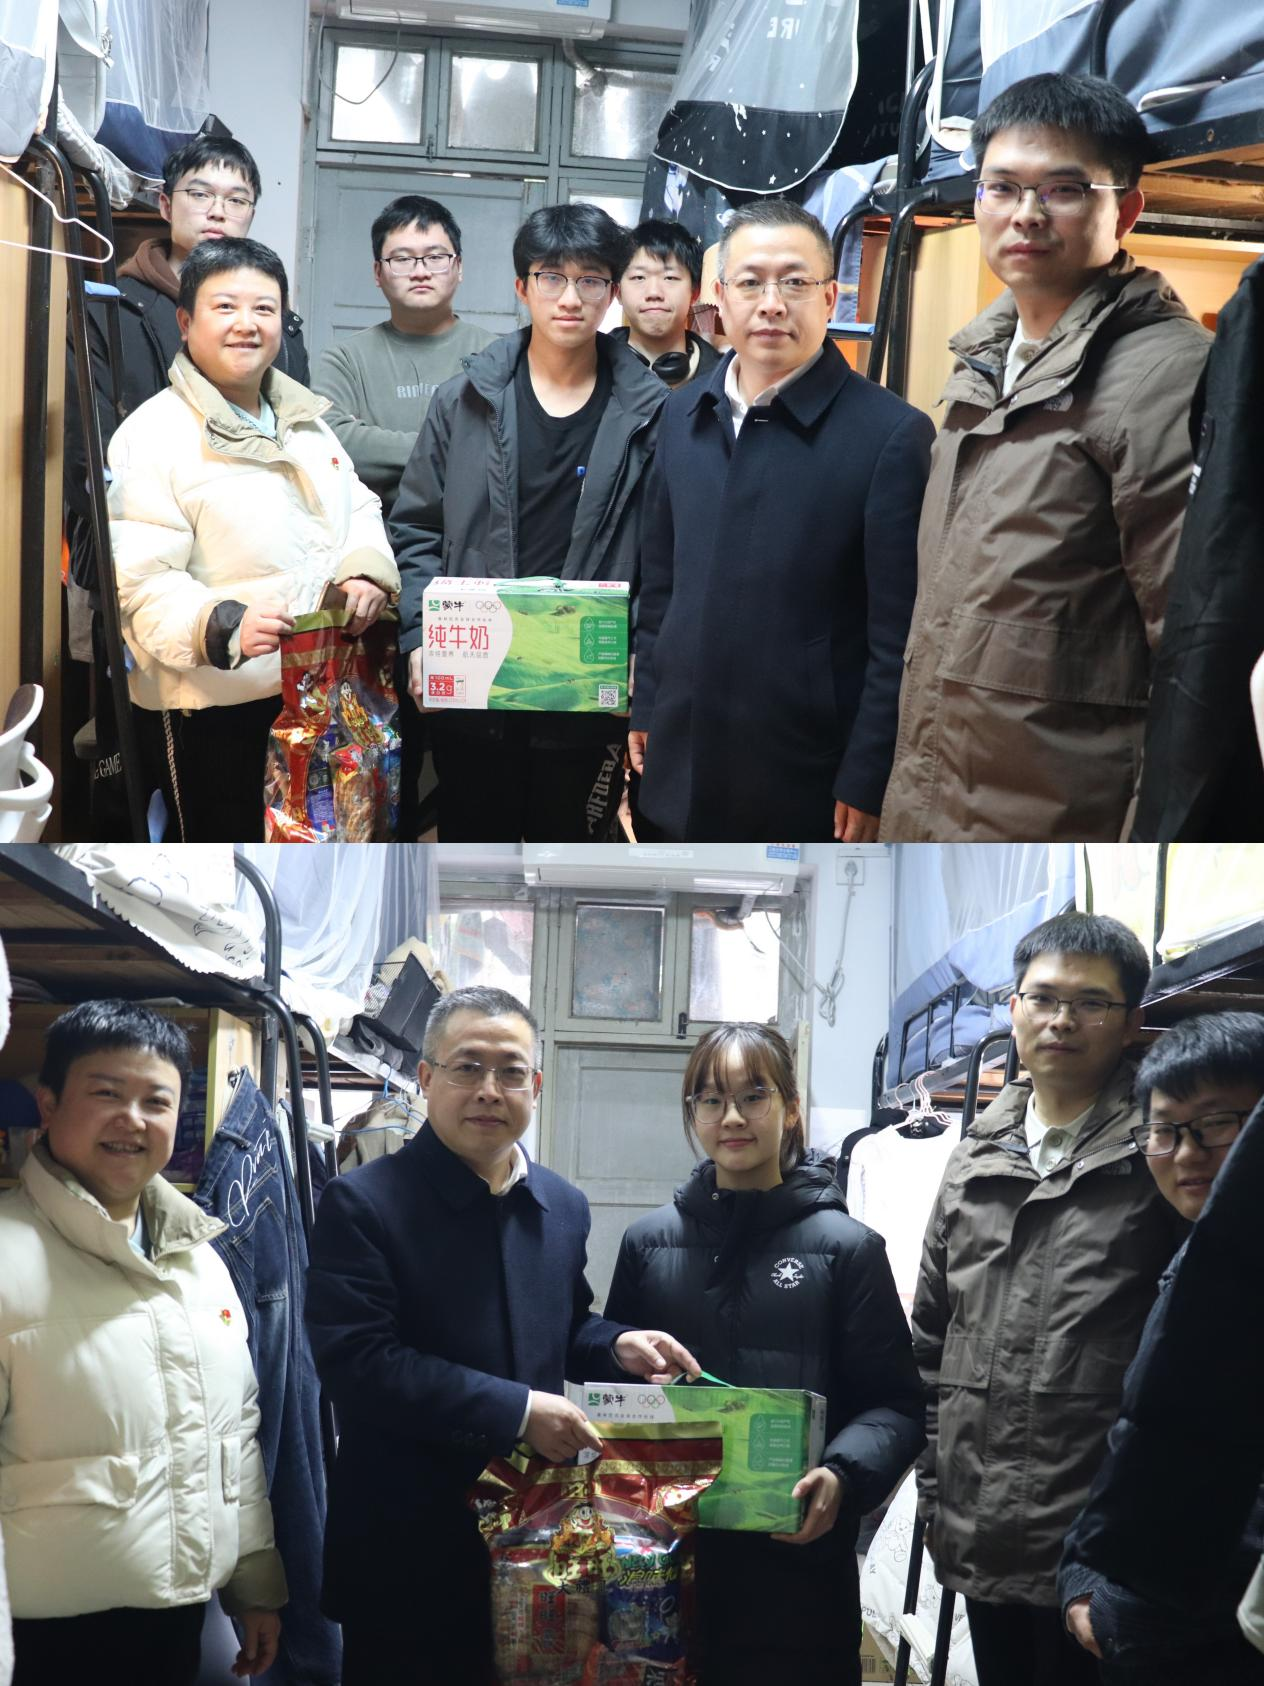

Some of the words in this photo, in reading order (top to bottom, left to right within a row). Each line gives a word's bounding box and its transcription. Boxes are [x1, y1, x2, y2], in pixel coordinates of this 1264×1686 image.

[442, 600, 464, 611] 蒙牛
[428, 624, 488, 650] 纯牛奶
[602, 1393, 626, 1407] 蒙牛
